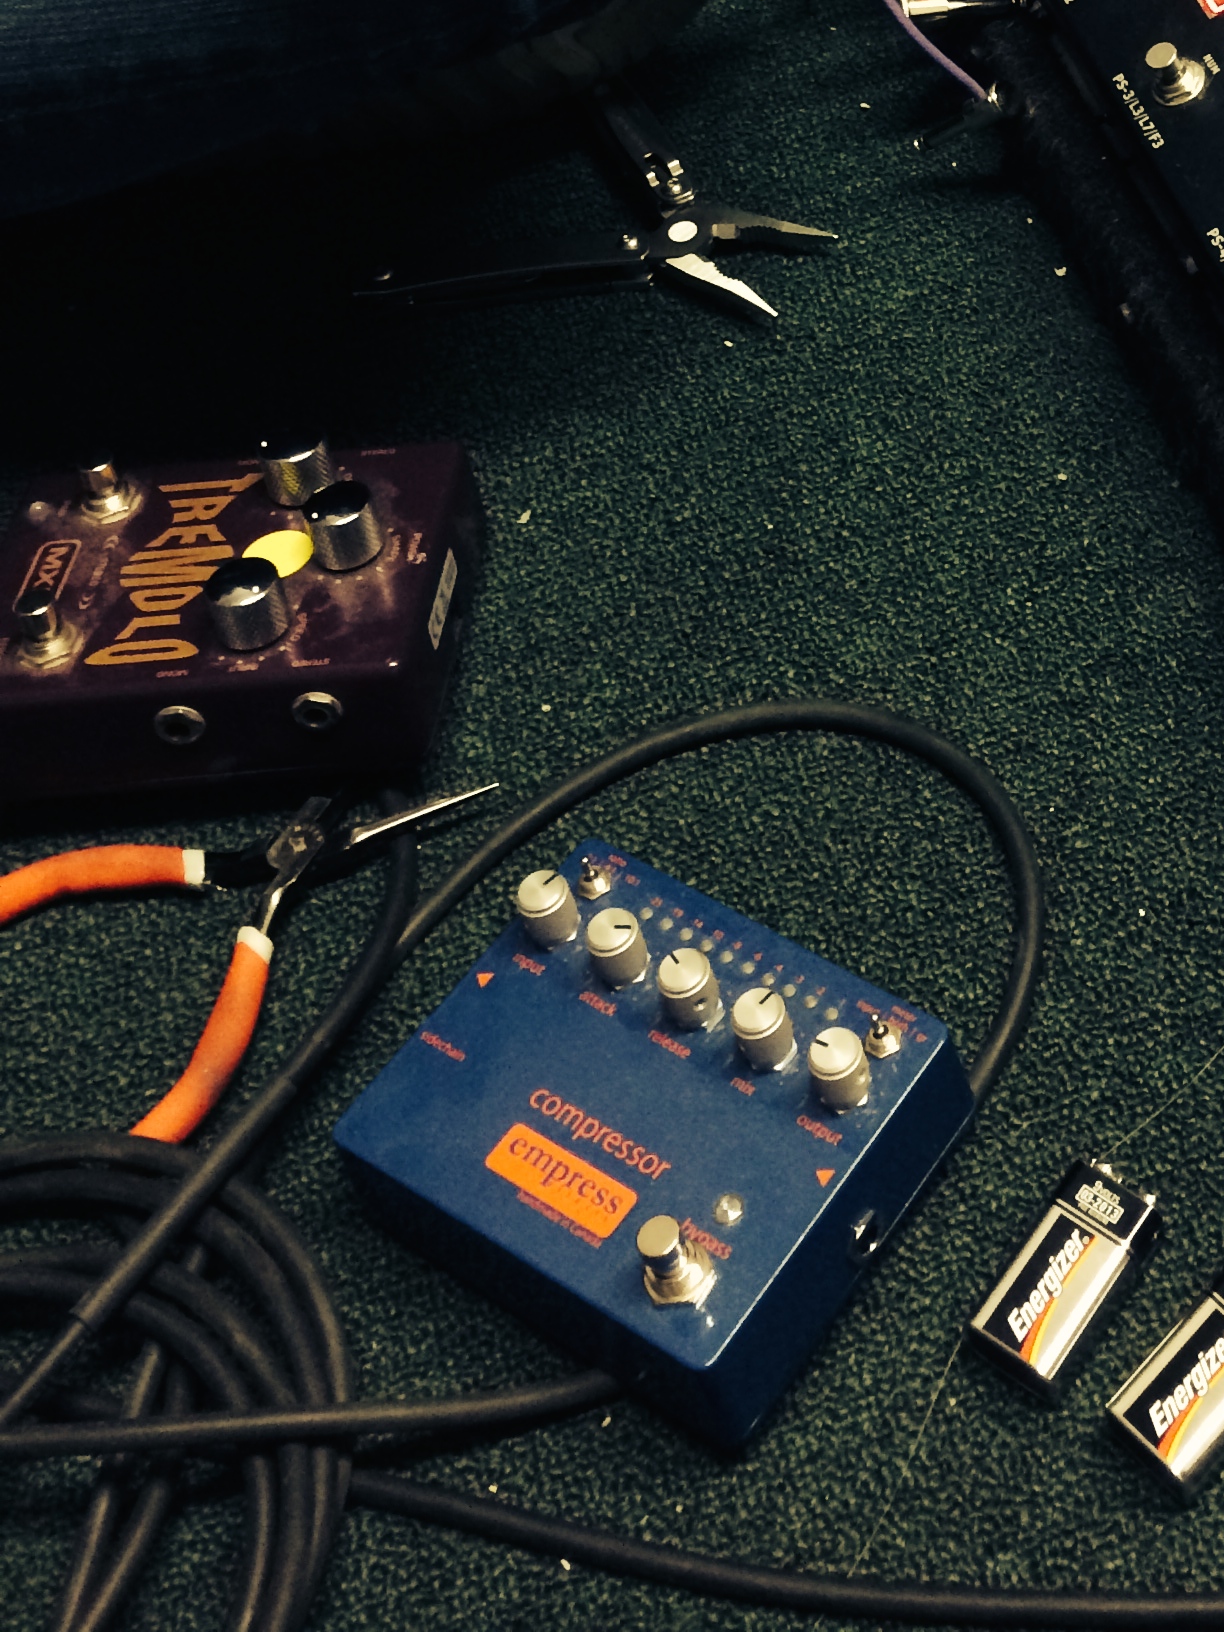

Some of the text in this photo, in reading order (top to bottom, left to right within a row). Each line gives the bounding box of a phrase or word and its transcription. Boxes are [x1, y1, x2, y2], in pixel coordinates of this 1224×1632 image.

[1202, 52, 1222, 76] NUM
[1111, 72, 1166, 150] PS-3/L3/L7/F3
[33, 545, 69, 591] MX
[84, 472, 266, 666] TREMOLO
[512, 953, 547, 976] input
[578, 991, 618, 1017] attack
[647, 1029, 692, 1060] release
[730, 1076, 757, 1097] mix
[529, 1087, 672, 1180] compressor
[796, 1114, 844, 1146] output
[507, 1135, 624, 1216] empress
[1078, 1189, 1120, 1219] 03-2013
[679, 1217, 733, 1261] bypass
[1006, 1227, 1087, 1344] Energizer
